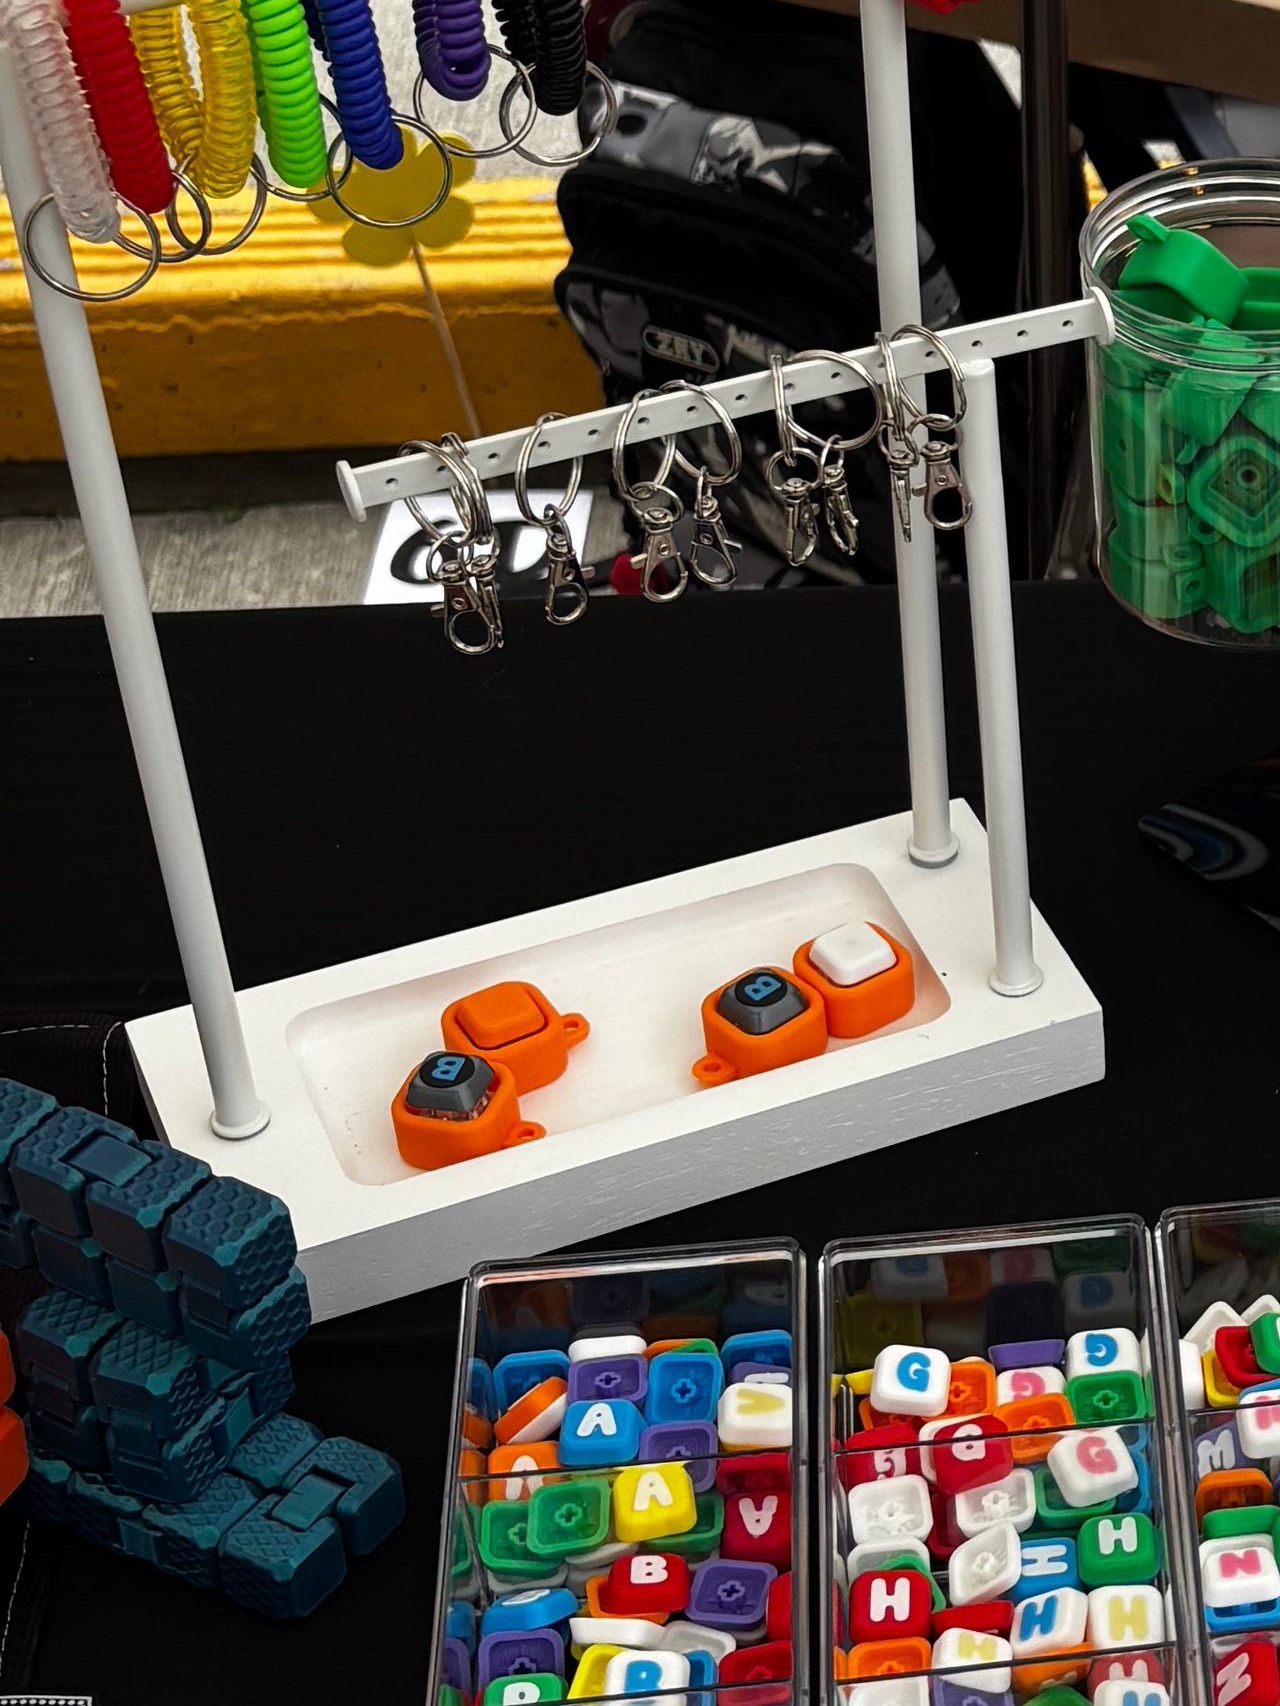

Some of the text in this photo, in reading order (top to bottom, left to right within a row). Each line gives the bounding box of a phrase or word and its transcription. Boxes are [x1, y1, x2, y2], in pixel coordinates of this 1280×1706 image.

[744, 976, 781, 1000] B
[432, 1057, 465, 1080] B
[897, 1353, 930, 1391] G
[577, 1403, 616, 1436] A
[1077, 1437, 1117, 1473] G
[1197, 1430, 1235, 1477] M
[634, 1472, 672, 1511] A
[1098, 1517, 1137, 1554] H
[631, 1556, 667, 1583] B
[1220, 1550, 1260, 1577] N
[870, 1578, 909, 1621] H
[1020, 1597, 1056, 1640] H
[1109, 1597, 1147, 1640] H
[958, 1633, 995, 1661] H
